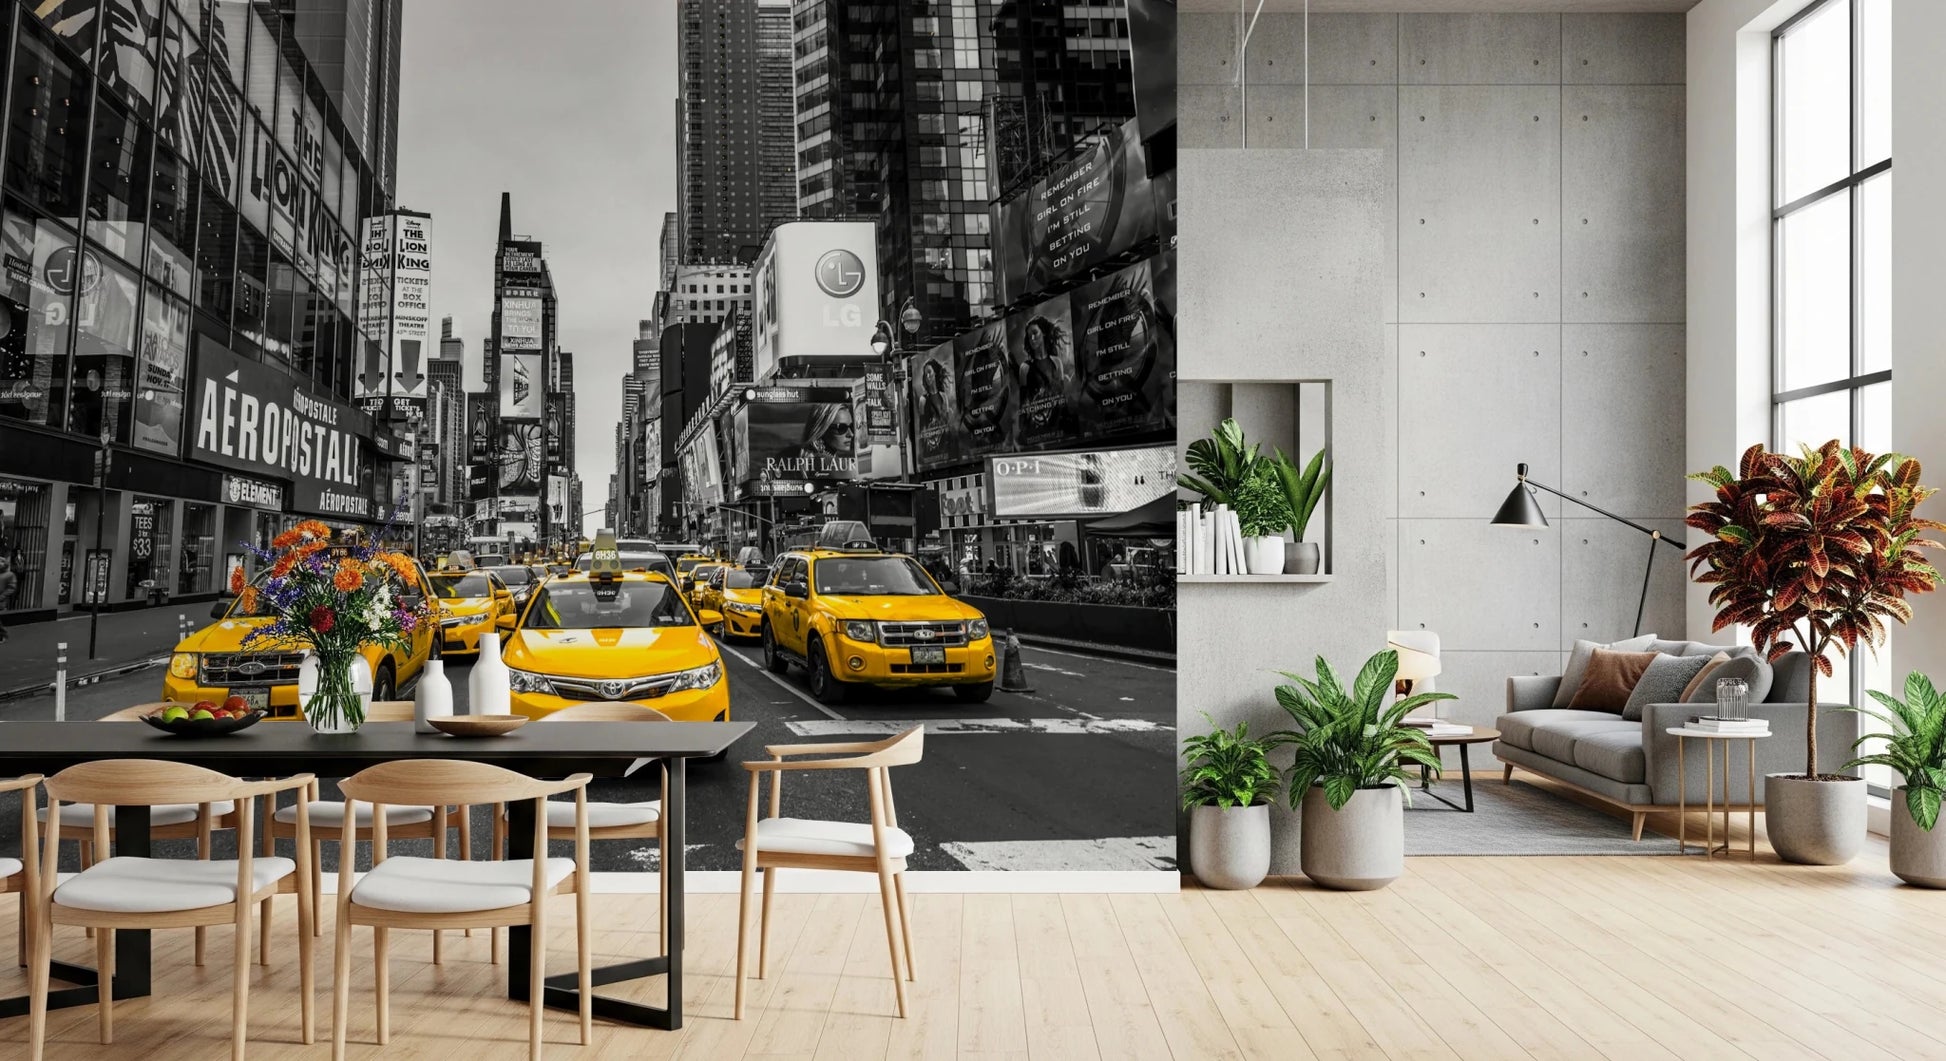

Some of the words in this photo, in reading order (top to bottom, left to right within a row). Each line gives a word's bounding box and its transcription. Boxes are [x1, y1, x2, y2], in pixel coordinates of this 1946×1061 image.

[292, 107, 321, 180] THE
[1040, 162, 1093, 201] REMEMBER
[251, 105, 306, 230] LION
[307, 180, 350, 280] KING
[1036, 205, 1058, 221] GIRL
[1060, 193, 1074, 207] ON
[1077, 177, 1100, 197] FIRE
[1047, 221, 1060, 234] I'M
[1063, 204, 1091, 224] STILL
[403, 229, 423, 239] THE
[1049, 222, 1091, 251] BETTING
[400, 238, 427, 253] LION
[397, 253, 430, 269] KING
[1053, 255, 1067, 268] ON
[1069, 243, 1090, 259] YOU
[397, 276, 429, 286] TICKETS
[403, 293, 422, 301] BOX
[504, 300, 536, 309] XINHUA
[1088, 288, 1131, 310] REMEMBER
[397, 301, 427, 310] OFFICE
[822, 304, 862, 327] LG
[1086, 325, 1104, 335] GIRL
[1105, 319, 1117, 329] ON
[1107, 341, 1131, 354] STILL
[866, 373, 883, 382] SOME
[1097, 366, 1133, 381] BETTING
[866, 381, 887, 390] WALLS
[756, 390, 786, 400] sunglass
[786, 390, 799, 398] hut
[867, 398, 882, 407] TALK
[1101, 397, 1115, 406] ON
[1115, 393, 1134, 403] YOU
[766, 457, 815, 472] RALPH
[820, 457, 857, 472] LAUR
[240, 482, 277, 506] ELEMENT
[319, 487, 368, 516] AÉROPOSTALE
[134, 516, 153, 530] TEES
[133, 538, 152, 556] $33
